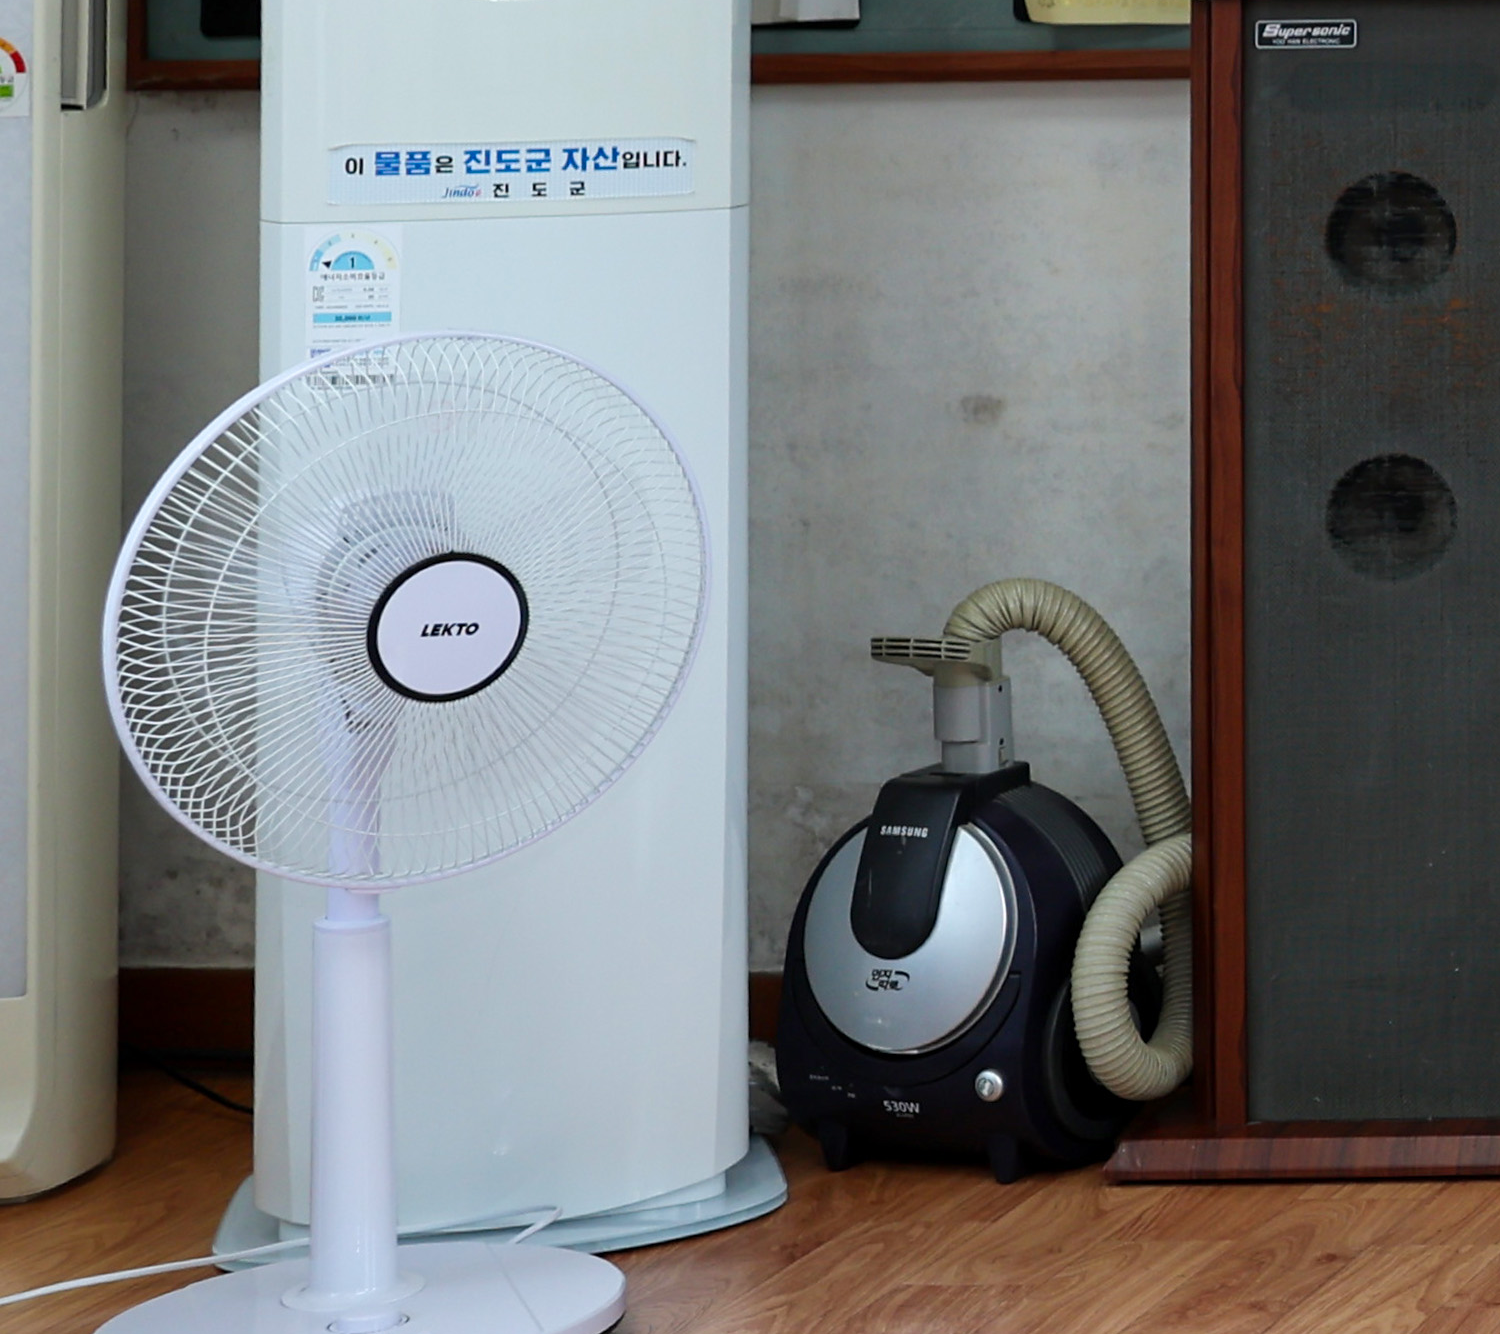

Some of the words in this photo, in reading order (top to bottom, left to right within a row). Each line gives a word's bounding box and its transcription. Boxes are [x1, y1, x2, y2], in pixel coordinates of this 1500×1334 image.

[345, 157, 365, 176] 이
[374, 150, 454, 177] 물품은
[463, 148, 552, 174] 진도군
[561, 145, 688, 173] 자산입니다.
[420, 619, 480, 639] LEKTO
[880, 824, 929, 839] SAMSUNG
[883, 1099, 921, 1114] 530W
